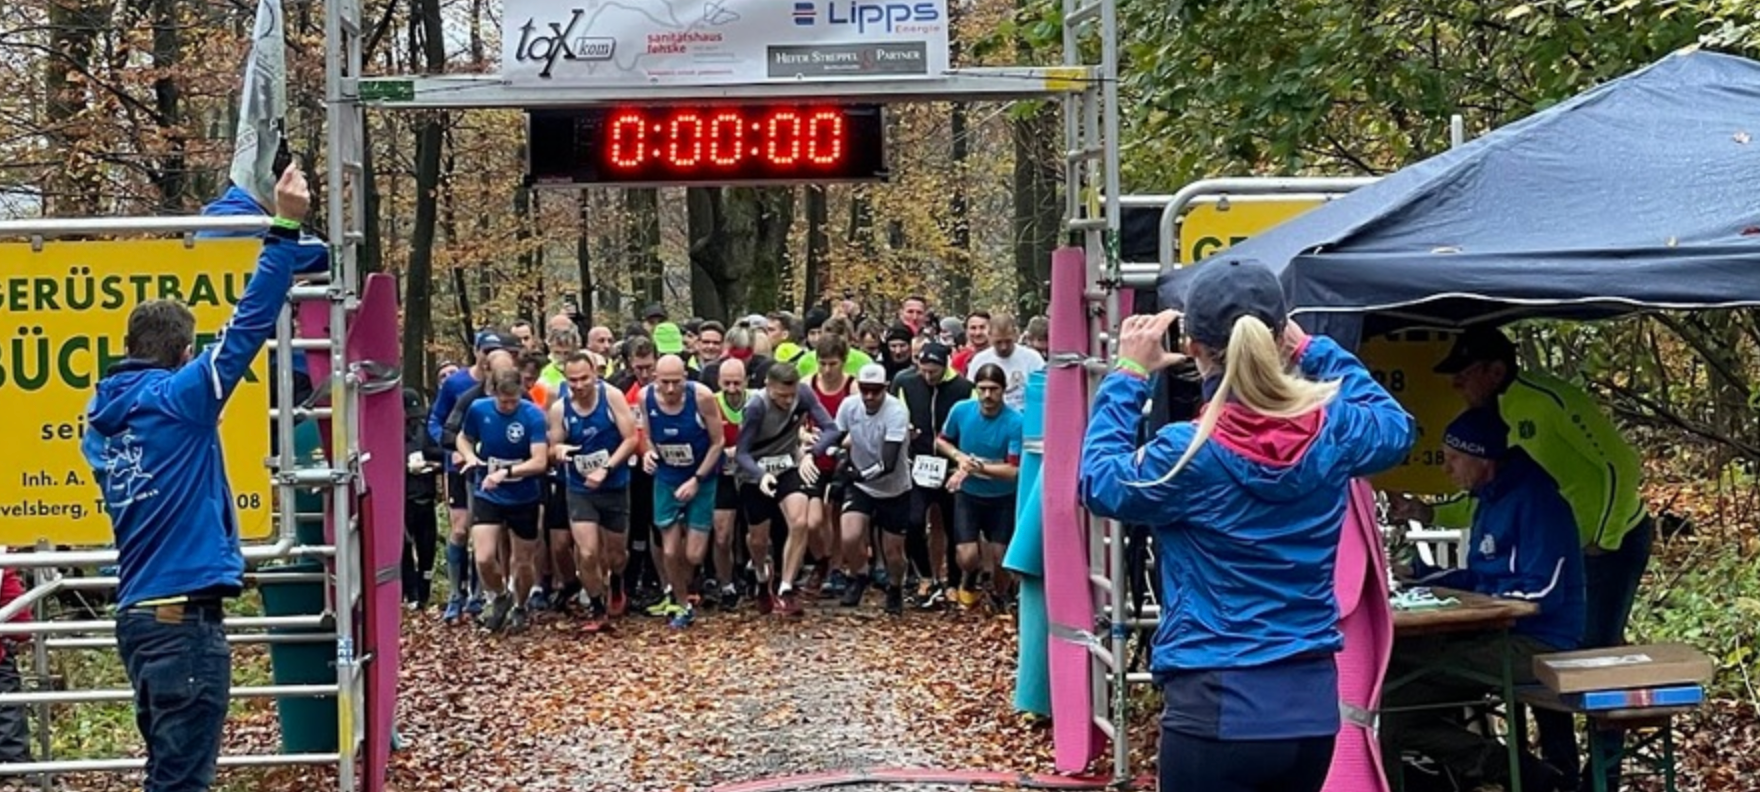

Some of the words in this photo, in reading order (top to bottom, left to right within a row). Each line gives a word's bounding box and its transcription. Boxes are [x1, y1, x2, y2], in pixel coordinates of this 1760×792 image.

[829, 1, 939, 33] Lipps
[895, 25, 940, 33] Energie
[876, 50, 920, 61] PARTNER
[612, 114, 843, 166] 0:00:00
[0, 266, 252, 312] ERÜSTBAU
[41, 416, 84, 440] sei
[1445, 434, 1486, 455] COACH
[22, 472, 57, 486] Inh.
[65, 471, 85, 485] A.
[237, 495, 260, 509] 08
